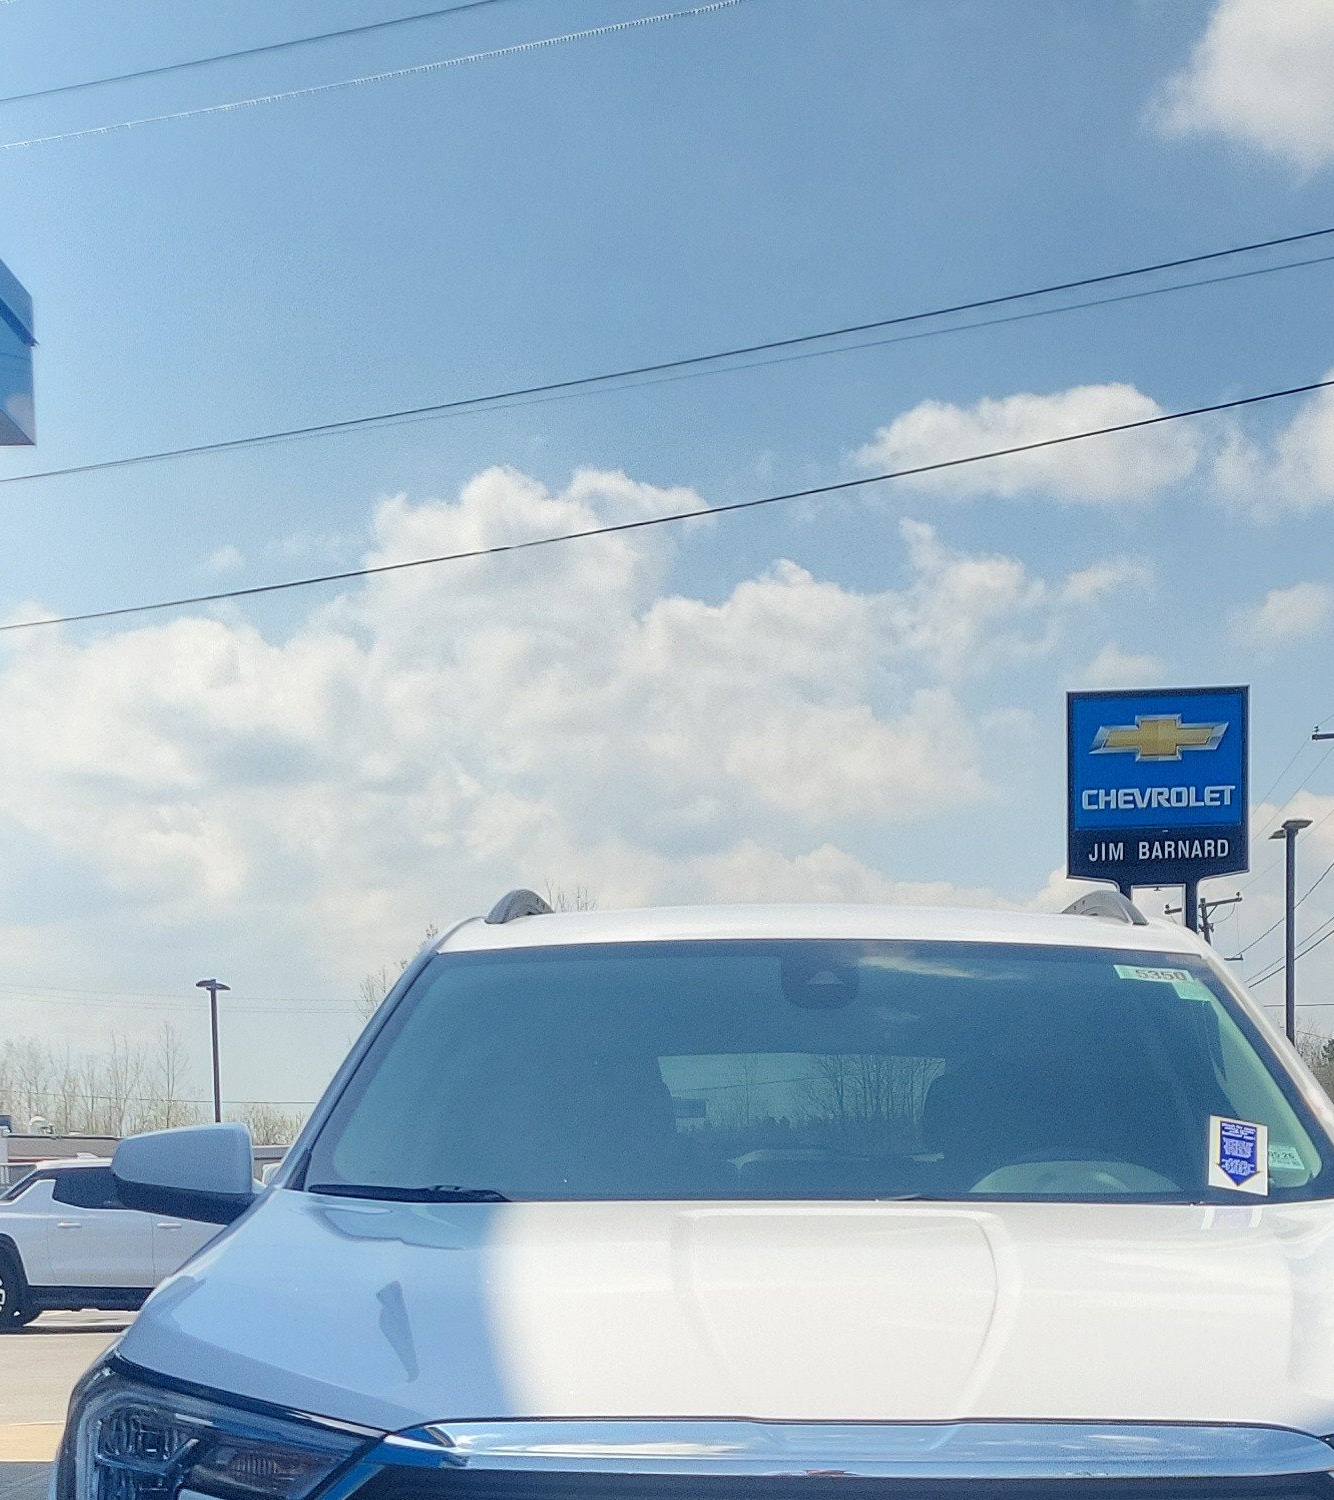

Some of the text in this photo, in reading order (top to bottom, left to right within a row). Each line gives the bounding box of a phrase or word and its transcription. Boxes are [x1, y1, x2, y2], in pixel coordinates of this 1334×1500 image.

[1082, 785, 1236, 810] CHEVROLET
[1088, 839, 1229, 862] JIM BARNARD
